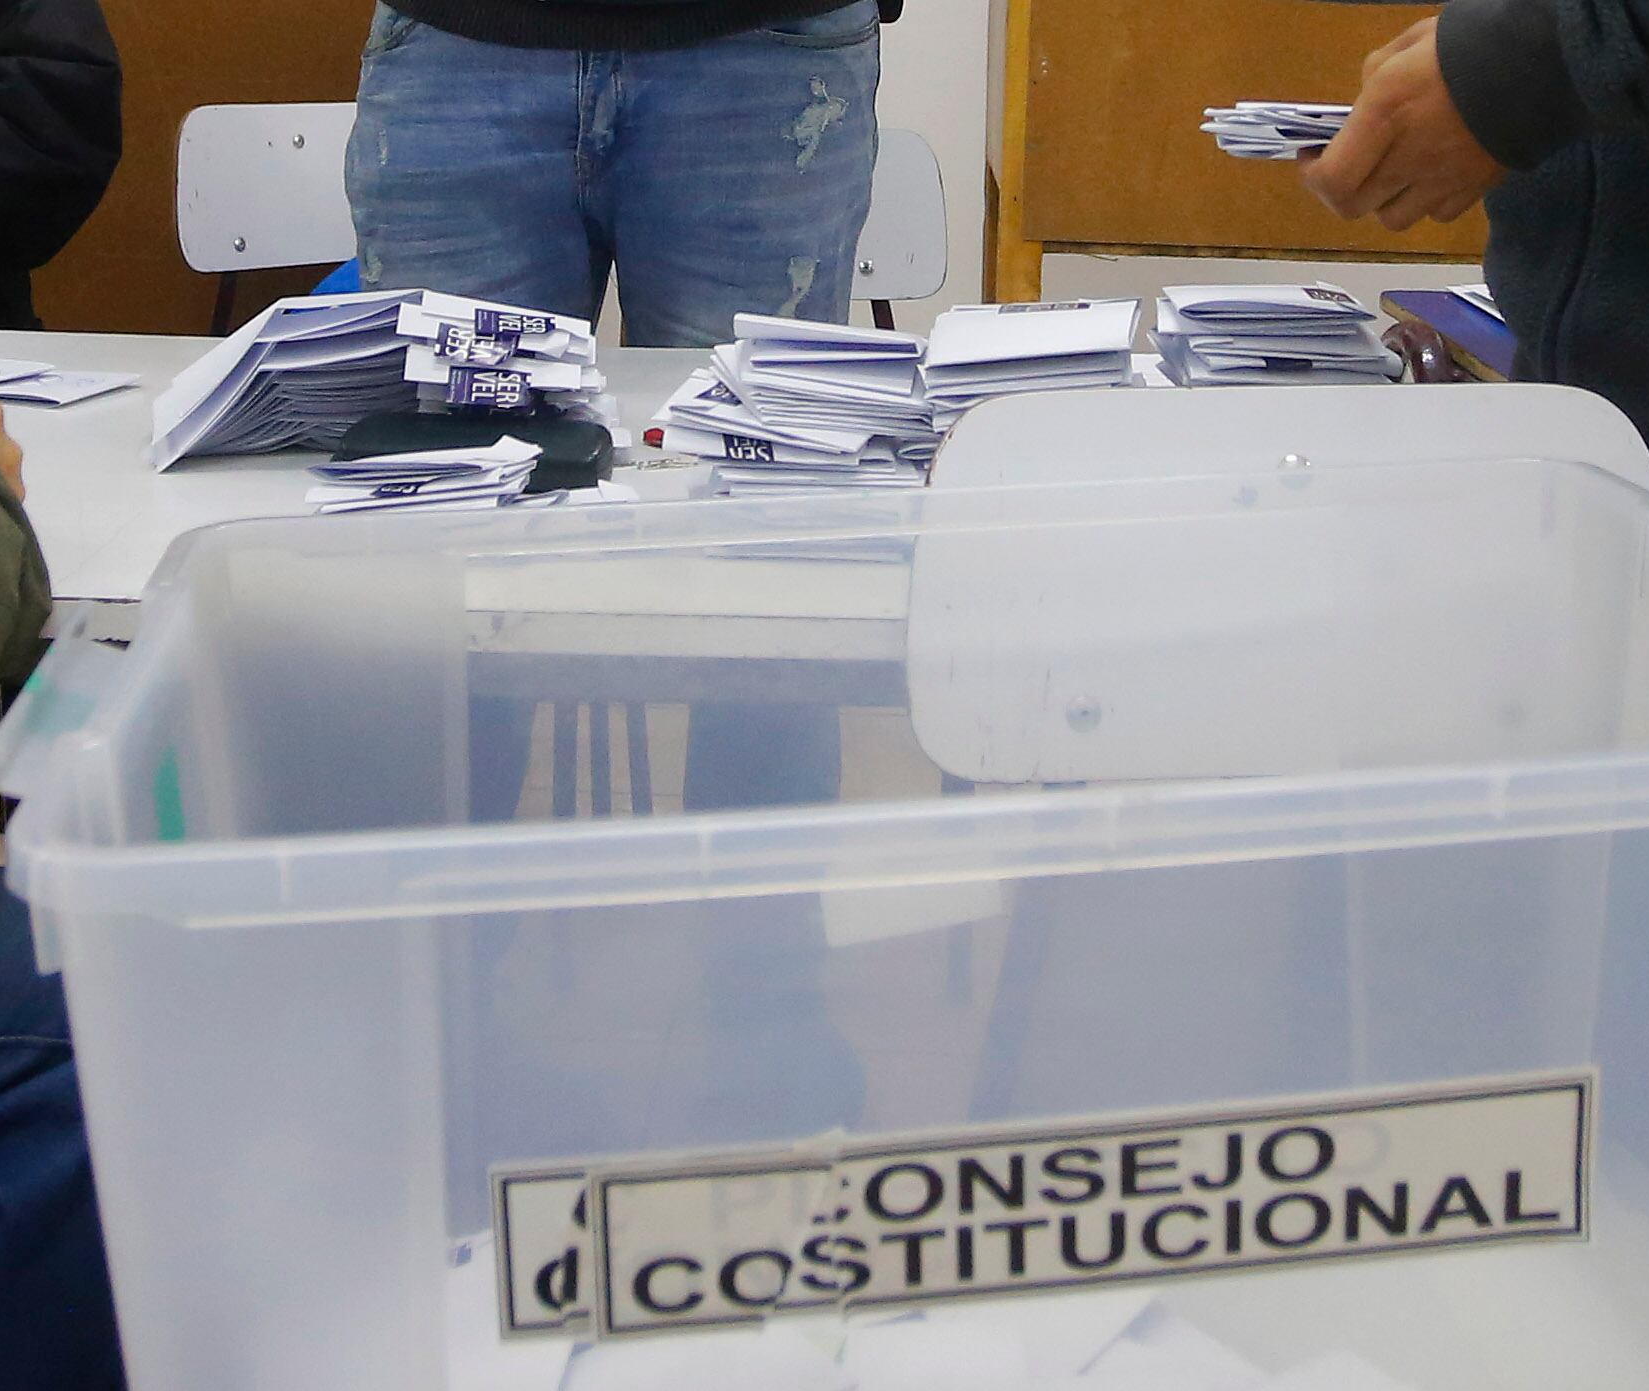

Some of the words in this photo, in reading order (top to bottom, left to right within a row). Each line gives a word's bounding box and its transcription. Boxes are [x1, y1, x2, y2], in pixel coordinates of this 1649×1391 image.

[499, 314, 521, 333] VEL
[522, 316, 546, 333] SER
[446, 327, 470, 359] SER
[470, 334, 495, 359] VEL
[472, 371, 497, 402] VEL
[497, 372, 521, 407] SER
[814, 1126, 1336, 1226] ONSEJO
